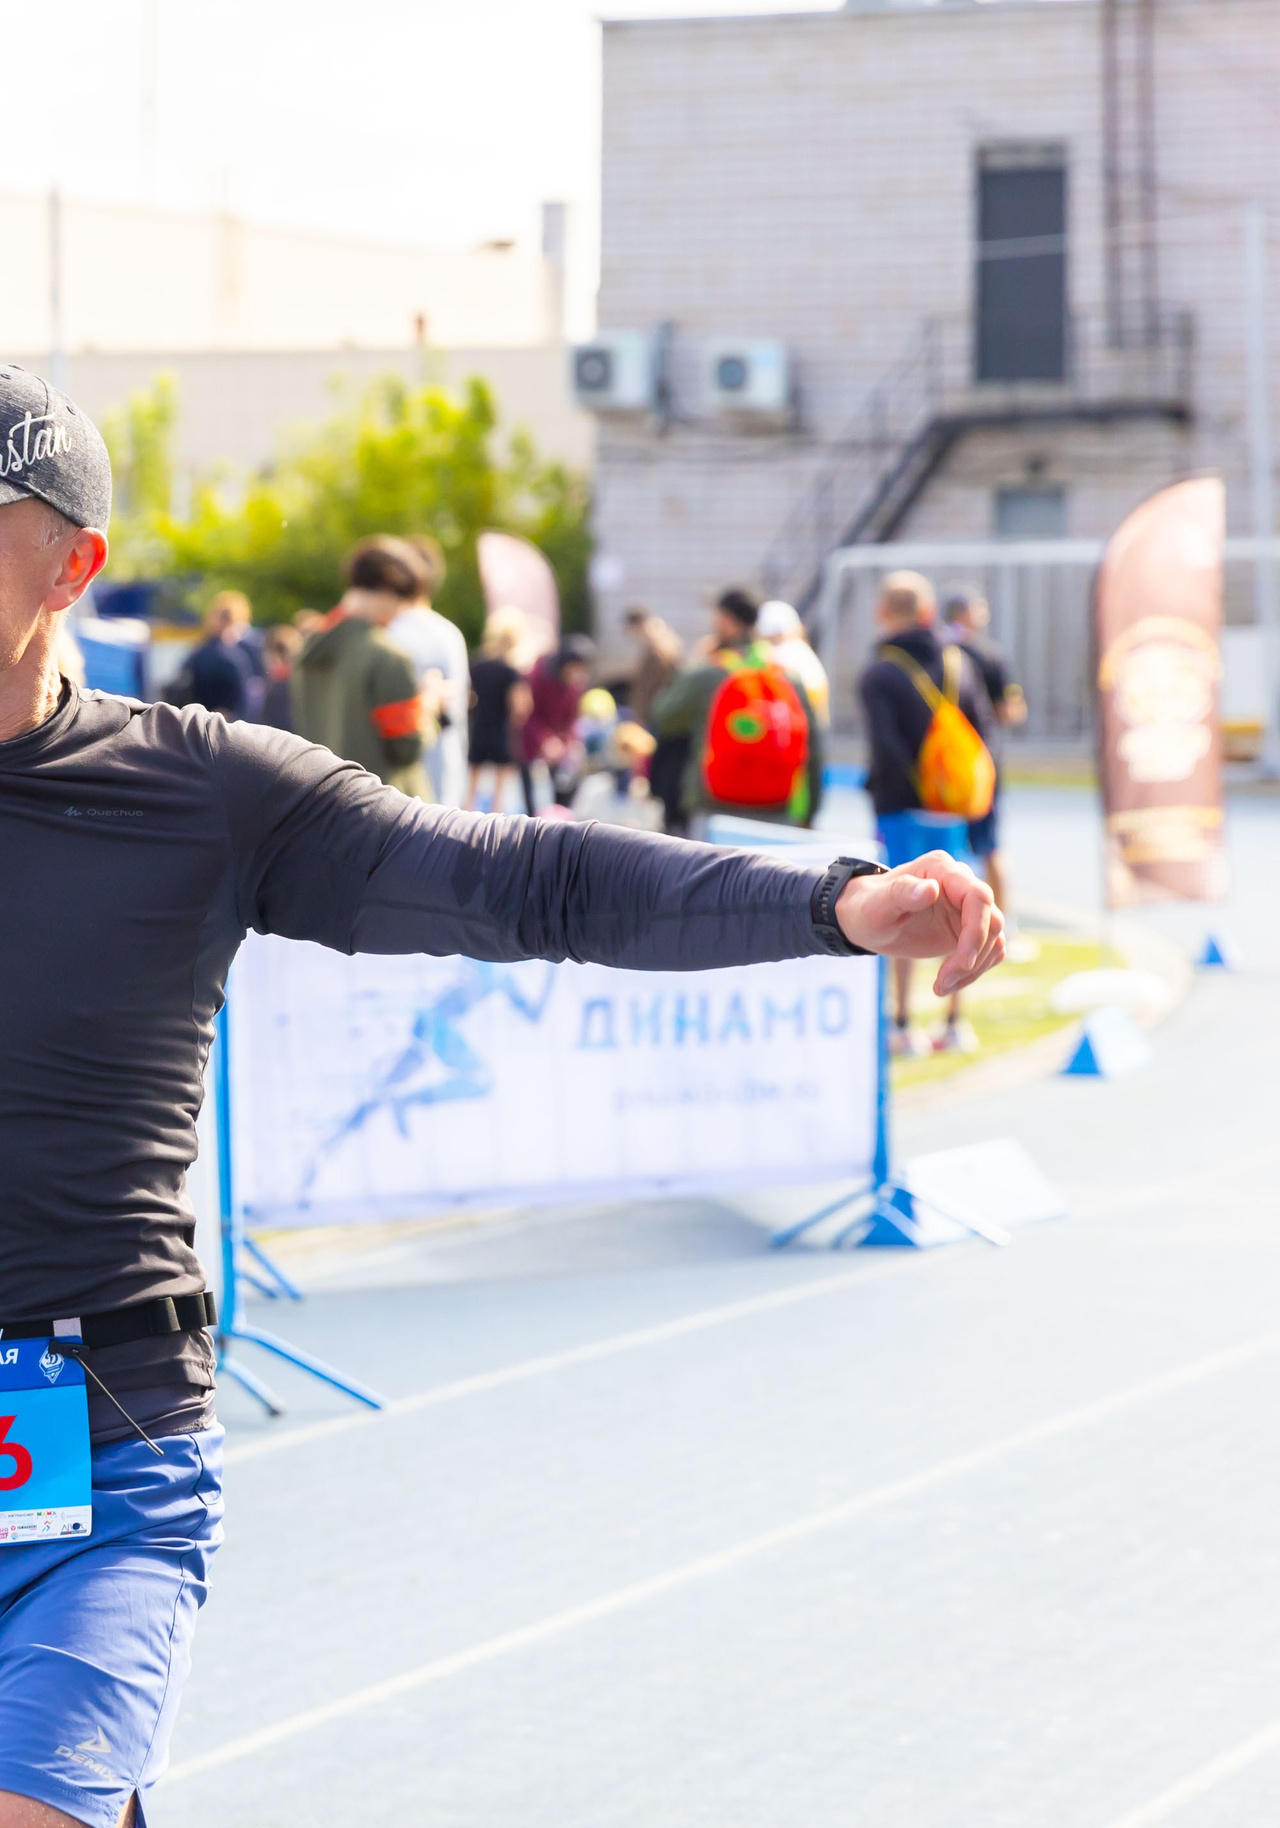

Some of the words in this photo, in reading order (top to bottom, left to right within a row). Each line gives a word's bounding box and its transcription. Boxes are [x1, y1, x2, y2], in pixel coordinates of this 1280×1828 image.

[86, 808, 144, 817] Quechua
[575, 985, 851, 1049] ДИНАМО
[54, 1744, 117, 1782] DEMIX
